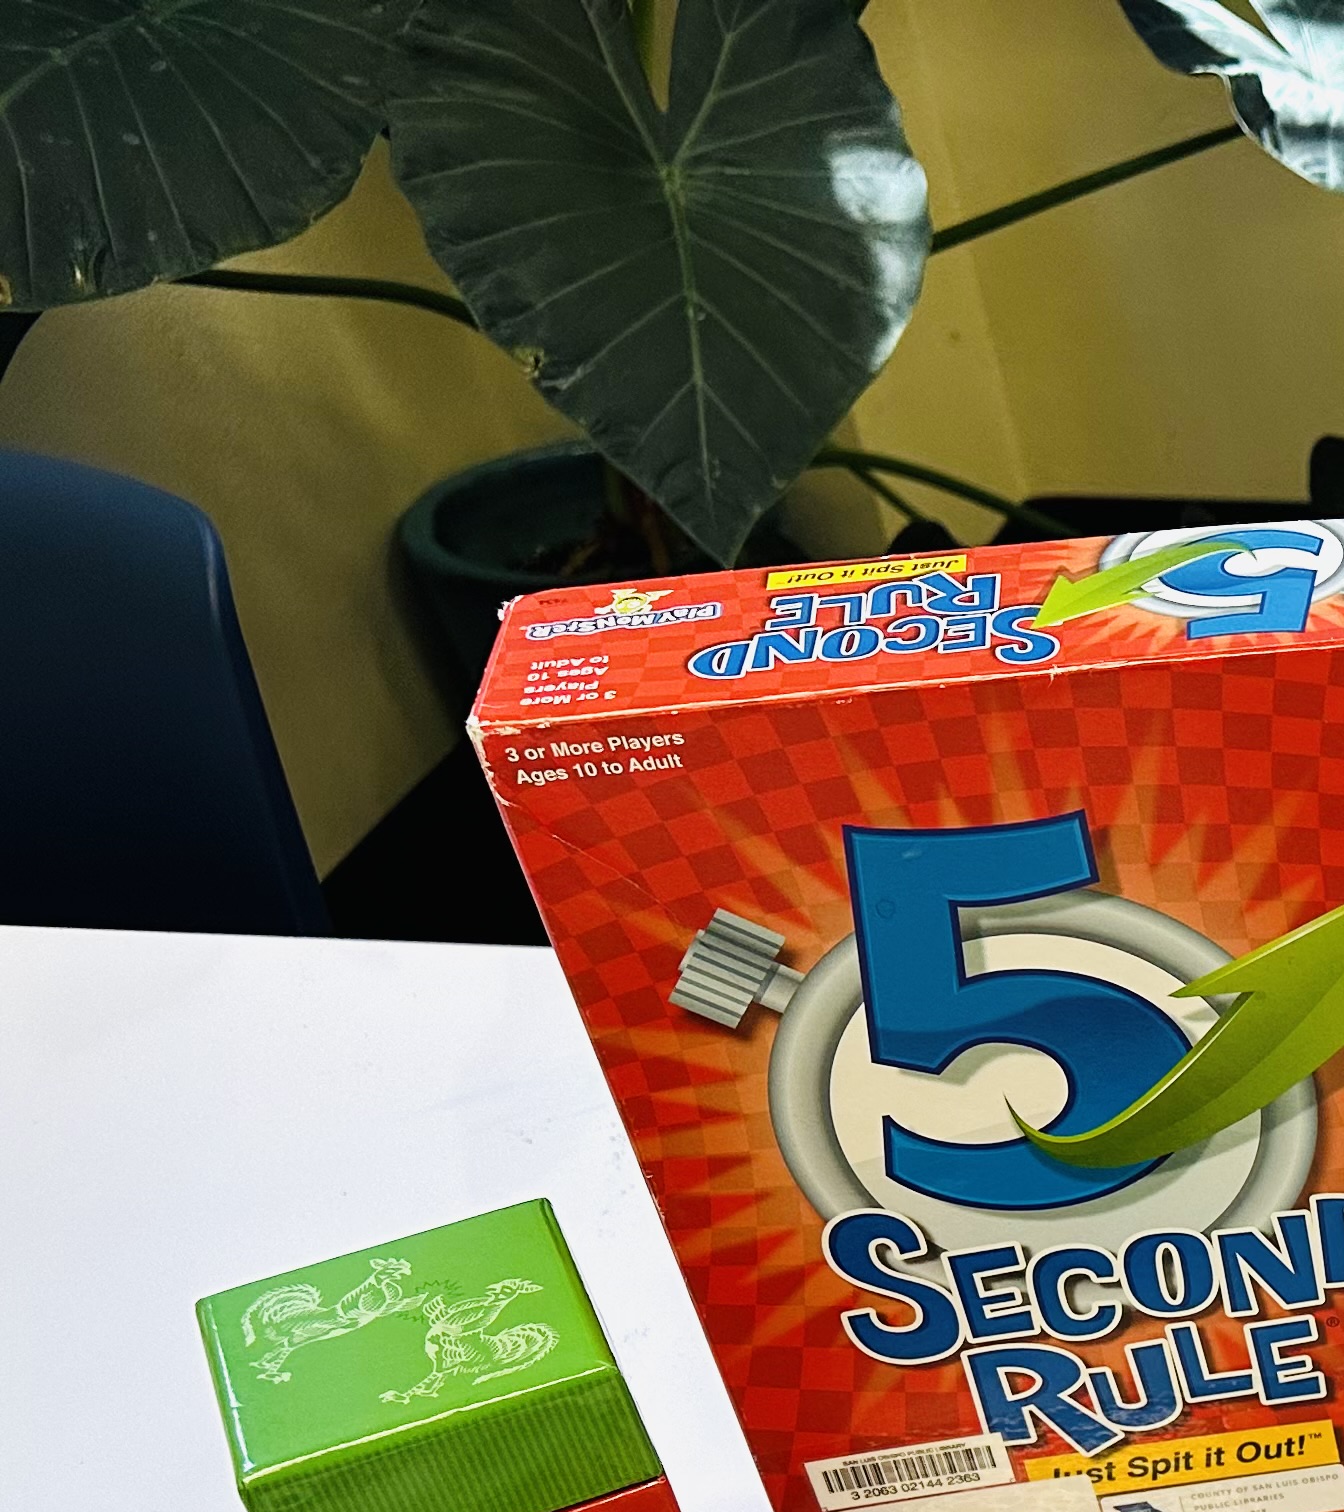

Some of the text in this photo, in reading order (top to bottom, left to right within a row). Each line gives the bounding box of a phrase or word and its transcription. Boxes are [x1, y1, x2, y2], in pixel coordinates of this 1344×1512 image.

[788, 556, 960, 585] Just Spit it Out!
[1158, 529, 1323, 640] 5
[766, 571, 1001, 630] RULE
[688, 604, 1060, 679] SECOND
[505, 731, 684, 763] 3 or More Players
[516, 753, 683, 786] Ages 10 to Adult
[842, 810, 1197, 1211] 5
[961, 1313, 1326, 1459] RULE
[1128, 1436, 1306, 1480] Spit it Out!
